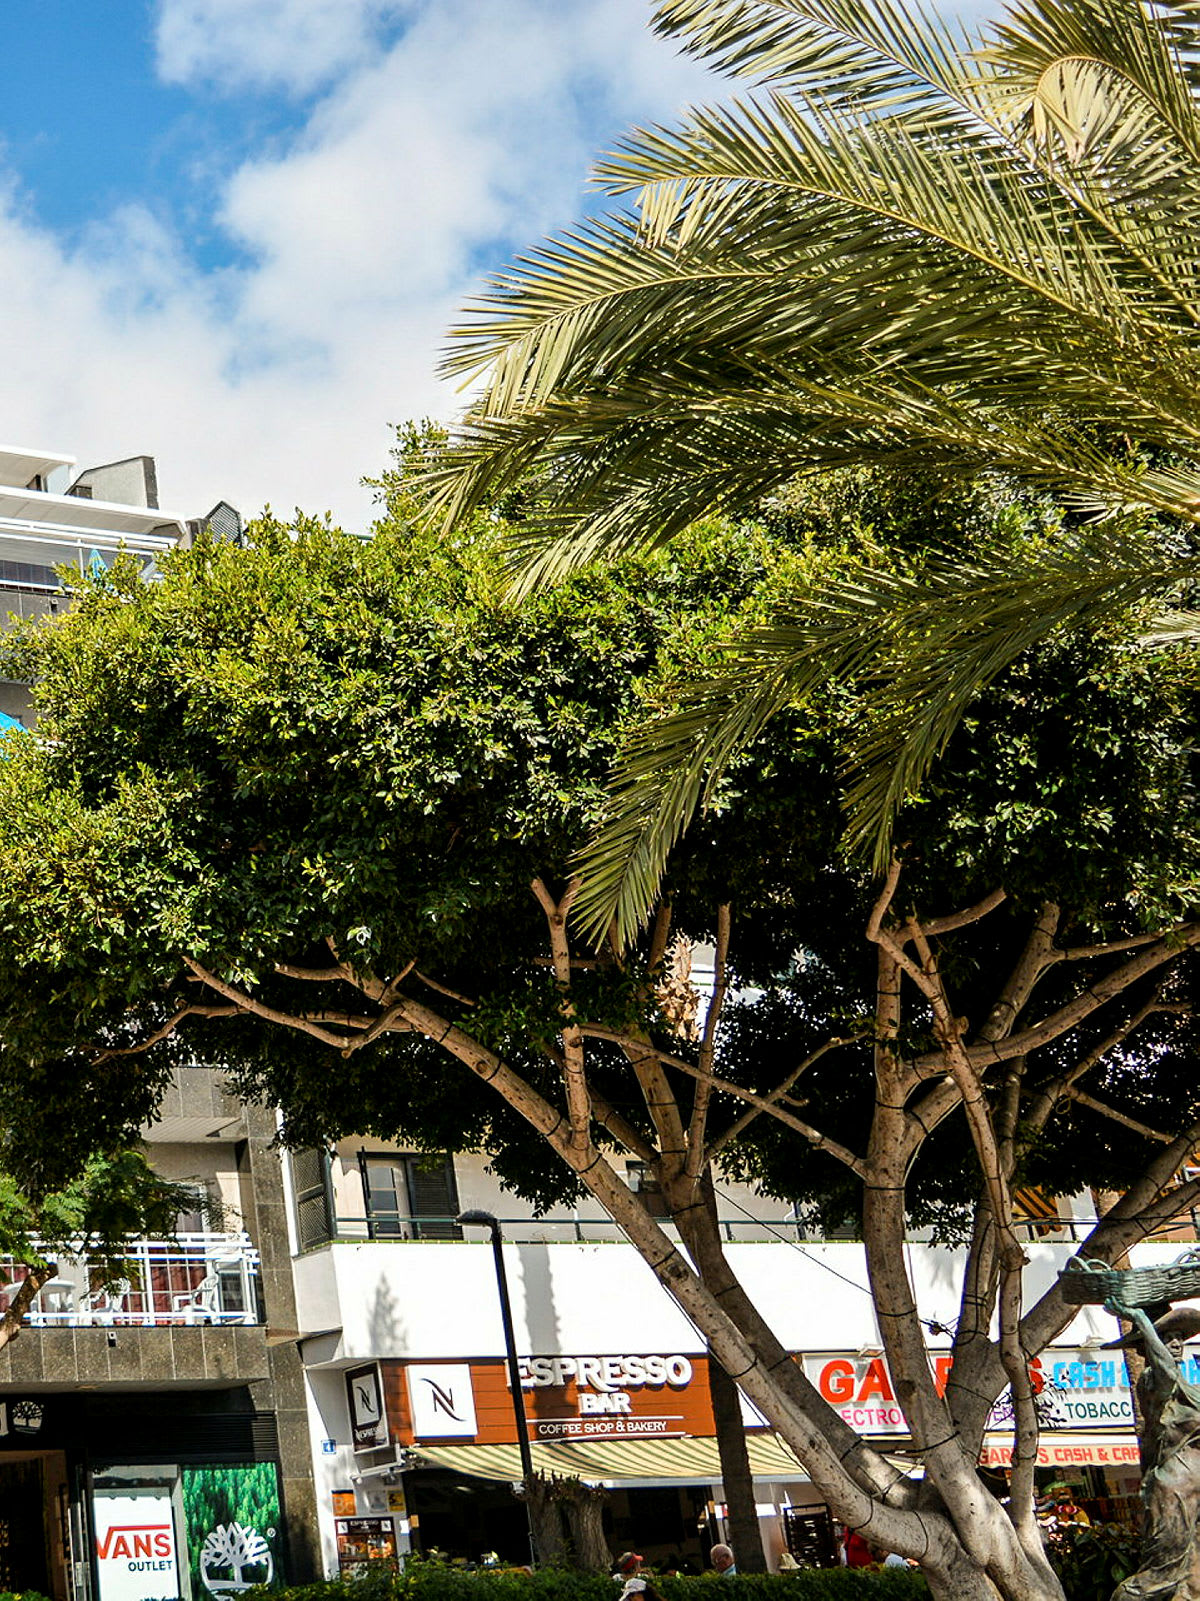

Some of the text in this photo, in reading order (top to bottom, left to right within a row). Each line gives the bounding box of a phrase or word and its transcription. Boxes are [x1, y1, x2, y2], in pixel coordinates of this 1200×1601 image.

[504, 1355, 693, 1392] ESPRESSO
[1052, 1360, 1116, 1389] CASH
[577, 1392, 633, 1415] BAR
[1064, 1401, 1132, 1419] TOBACC
[538, 1420, 667, 1435] COFFEE SHOP & BAKERY
[1053, 1447, 1093, 1462] CASH
[1096, 1447, 1110, 1462] &
[95, 1524, 172, 1560] VANS
[127, 1560, 173, 1572] OUTLET
